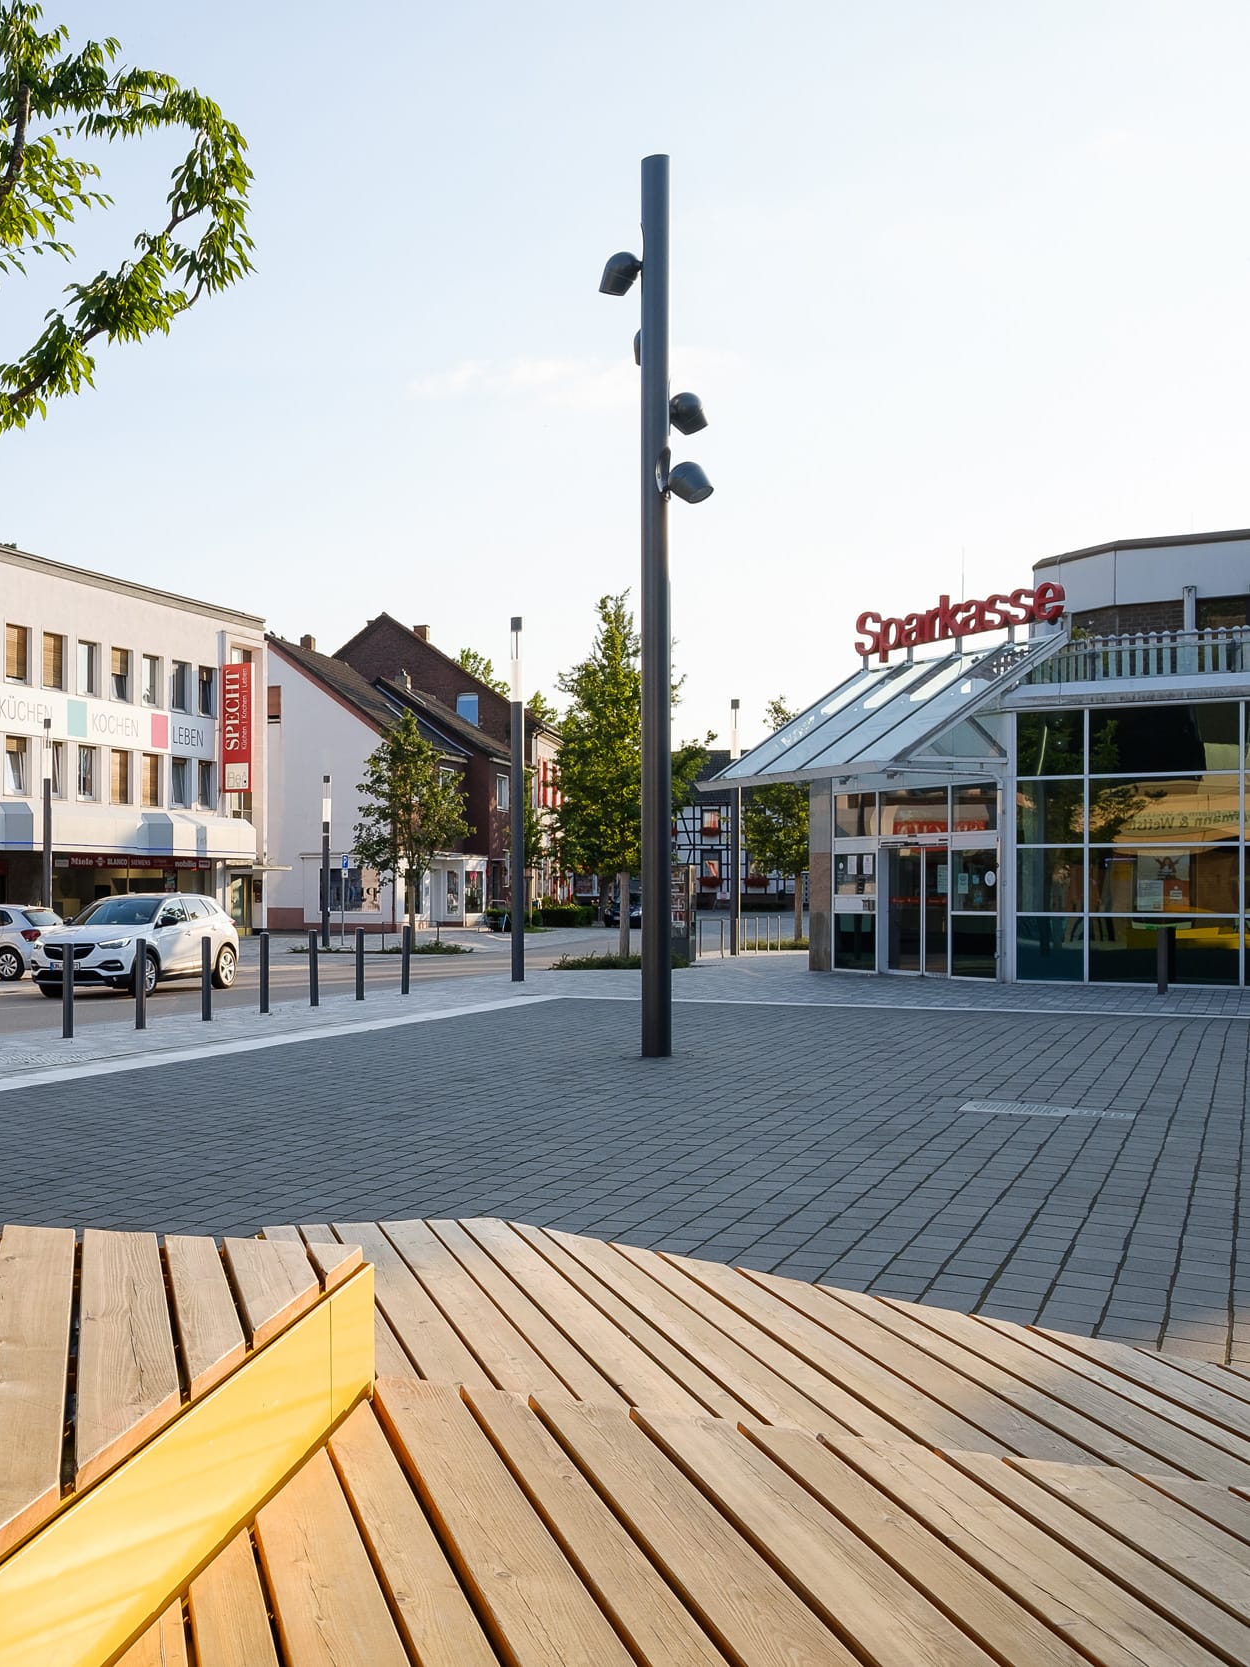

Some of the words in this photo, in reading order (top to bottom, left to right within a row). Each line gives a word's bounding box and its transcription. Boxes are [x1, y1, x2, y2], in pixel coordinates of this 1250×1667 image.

[854, 581, 1066, 663] Sparkasse
[91, 712, 139, 737] KOCHEN
[172, 726, 204, 747] LEBEN
[225, 669, 240, 751] SPECHT
